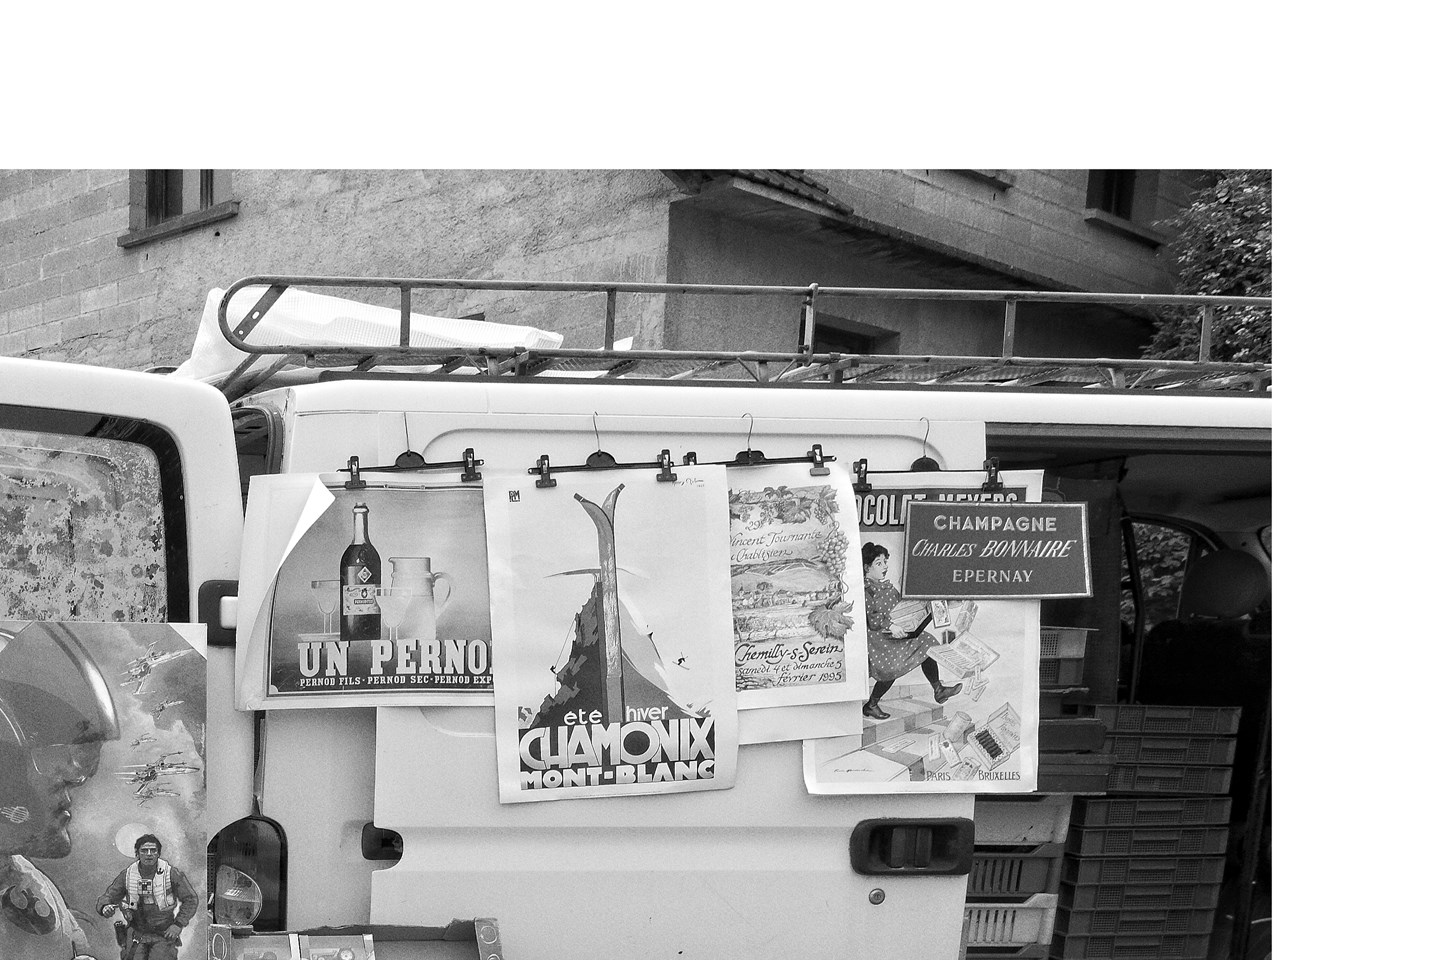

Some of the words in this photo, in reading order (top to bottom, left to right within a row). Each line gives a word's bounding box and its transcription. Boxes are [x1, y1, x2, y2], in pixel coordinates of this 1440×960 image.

[933, 514, 1057, 532] CHAMPAGNE
[979, 539, 1078, 558] BONNAIRE
[952, 569, 1034, 584] EPERNAY
[297, 640, 351, 677] UN
[370, 638, 494, 676] PERNO
[735, 641, 844, 667] Chemilly-s-Serein
[738, 663, 771, 675] samedi
[773, 664, 780, 674] 4
[781, 663, 790, 672] et
[793, 657, 835, 670] dimanche
[834, 660, 842, 669] 5
[299, 677, 336, 687] PERNOD
[339, 676, 361, 685] FILS
[367, 675, 406, 685] PERNOD
[410, 675, 429, 684] SEC
[434, 674, 470, 684] PERNOD
[473, 675, 494, 684] EXP
[773, 672, 816, 687] février
[818, 671, 842, 682] 1995
[625, 705, 669, 722] hiver
[519, 717, 715, 770] CHAMONIX
[520, 759, 715, 790] MONT-BLANC
[926, 770, 951, 781] PARIS
[978, 770, 1021, 781] BRUXELLES
